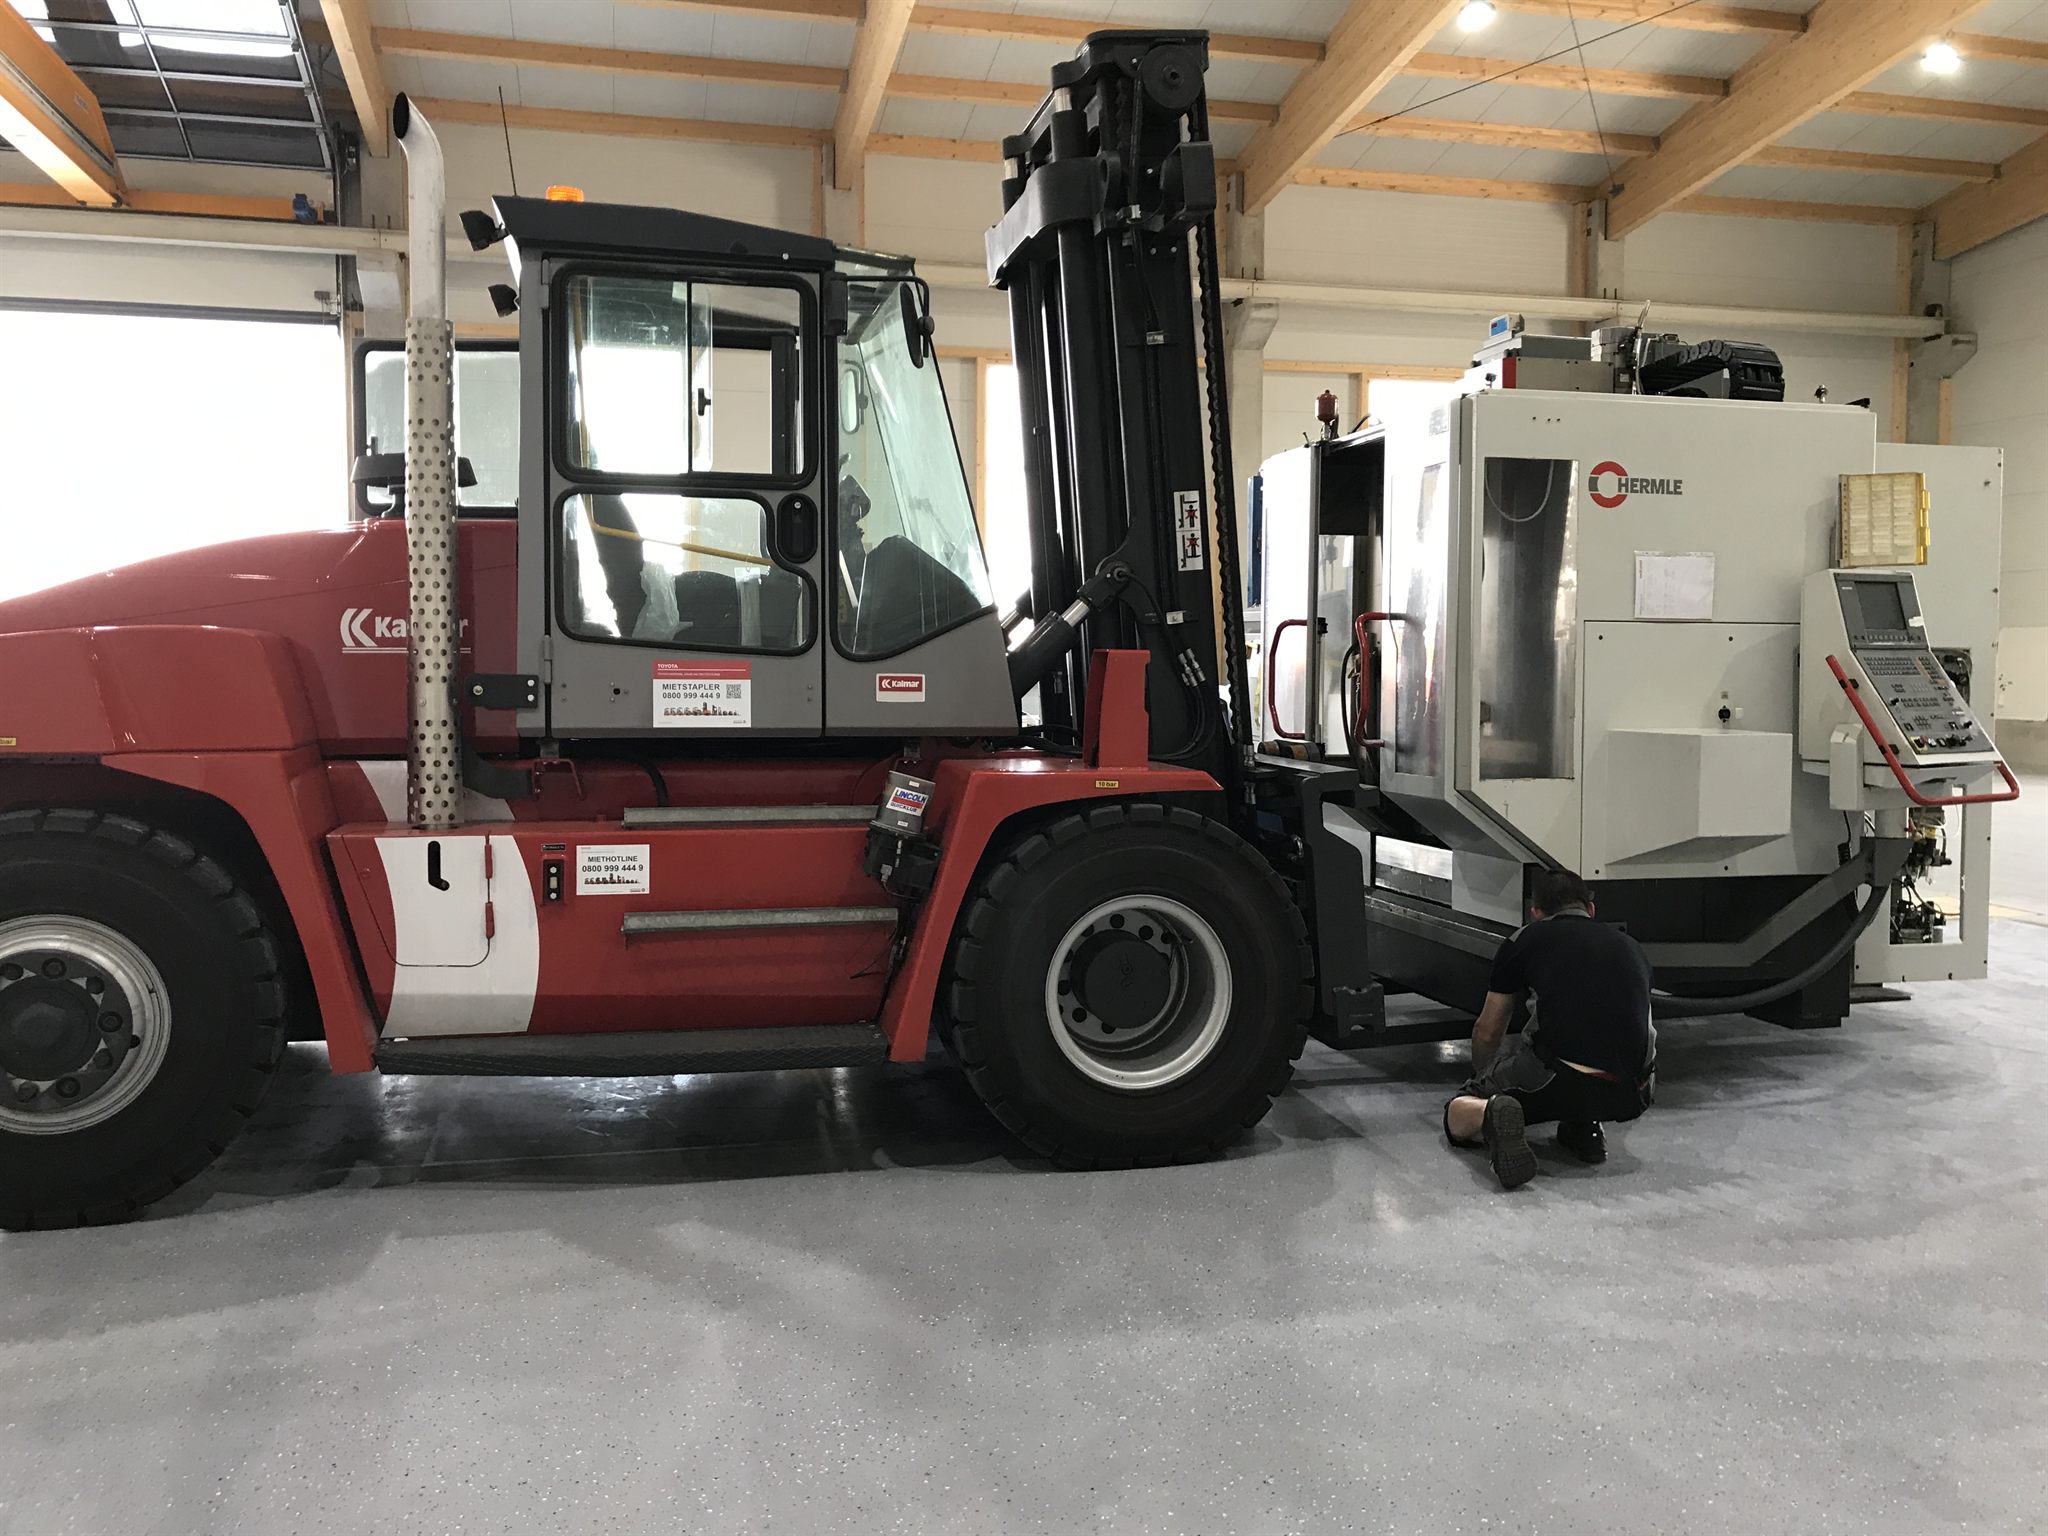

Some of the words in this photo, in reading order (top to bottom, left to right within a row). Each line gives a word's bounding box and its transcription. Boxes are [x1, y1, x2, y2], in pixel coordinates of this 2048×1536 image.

[1617, 477, 1683, 496] HERMLE
[375, 616, 469, 638] Kar
[662, 683, 720, 691] MIETSTAPLER
[891, 680, 920, 688] Kalmar
[895, 789, 927, 803] LINCOLN
[890, 802, 917, 812] QUICKLUB
[587, 855, 638, 863] MIETHOTLINE
[581, 864, 602, 873] 0800
[603, 864, 620, 872] 999
[621, 864, 637, 872] 444
[638, 863, 644, 872] 9
